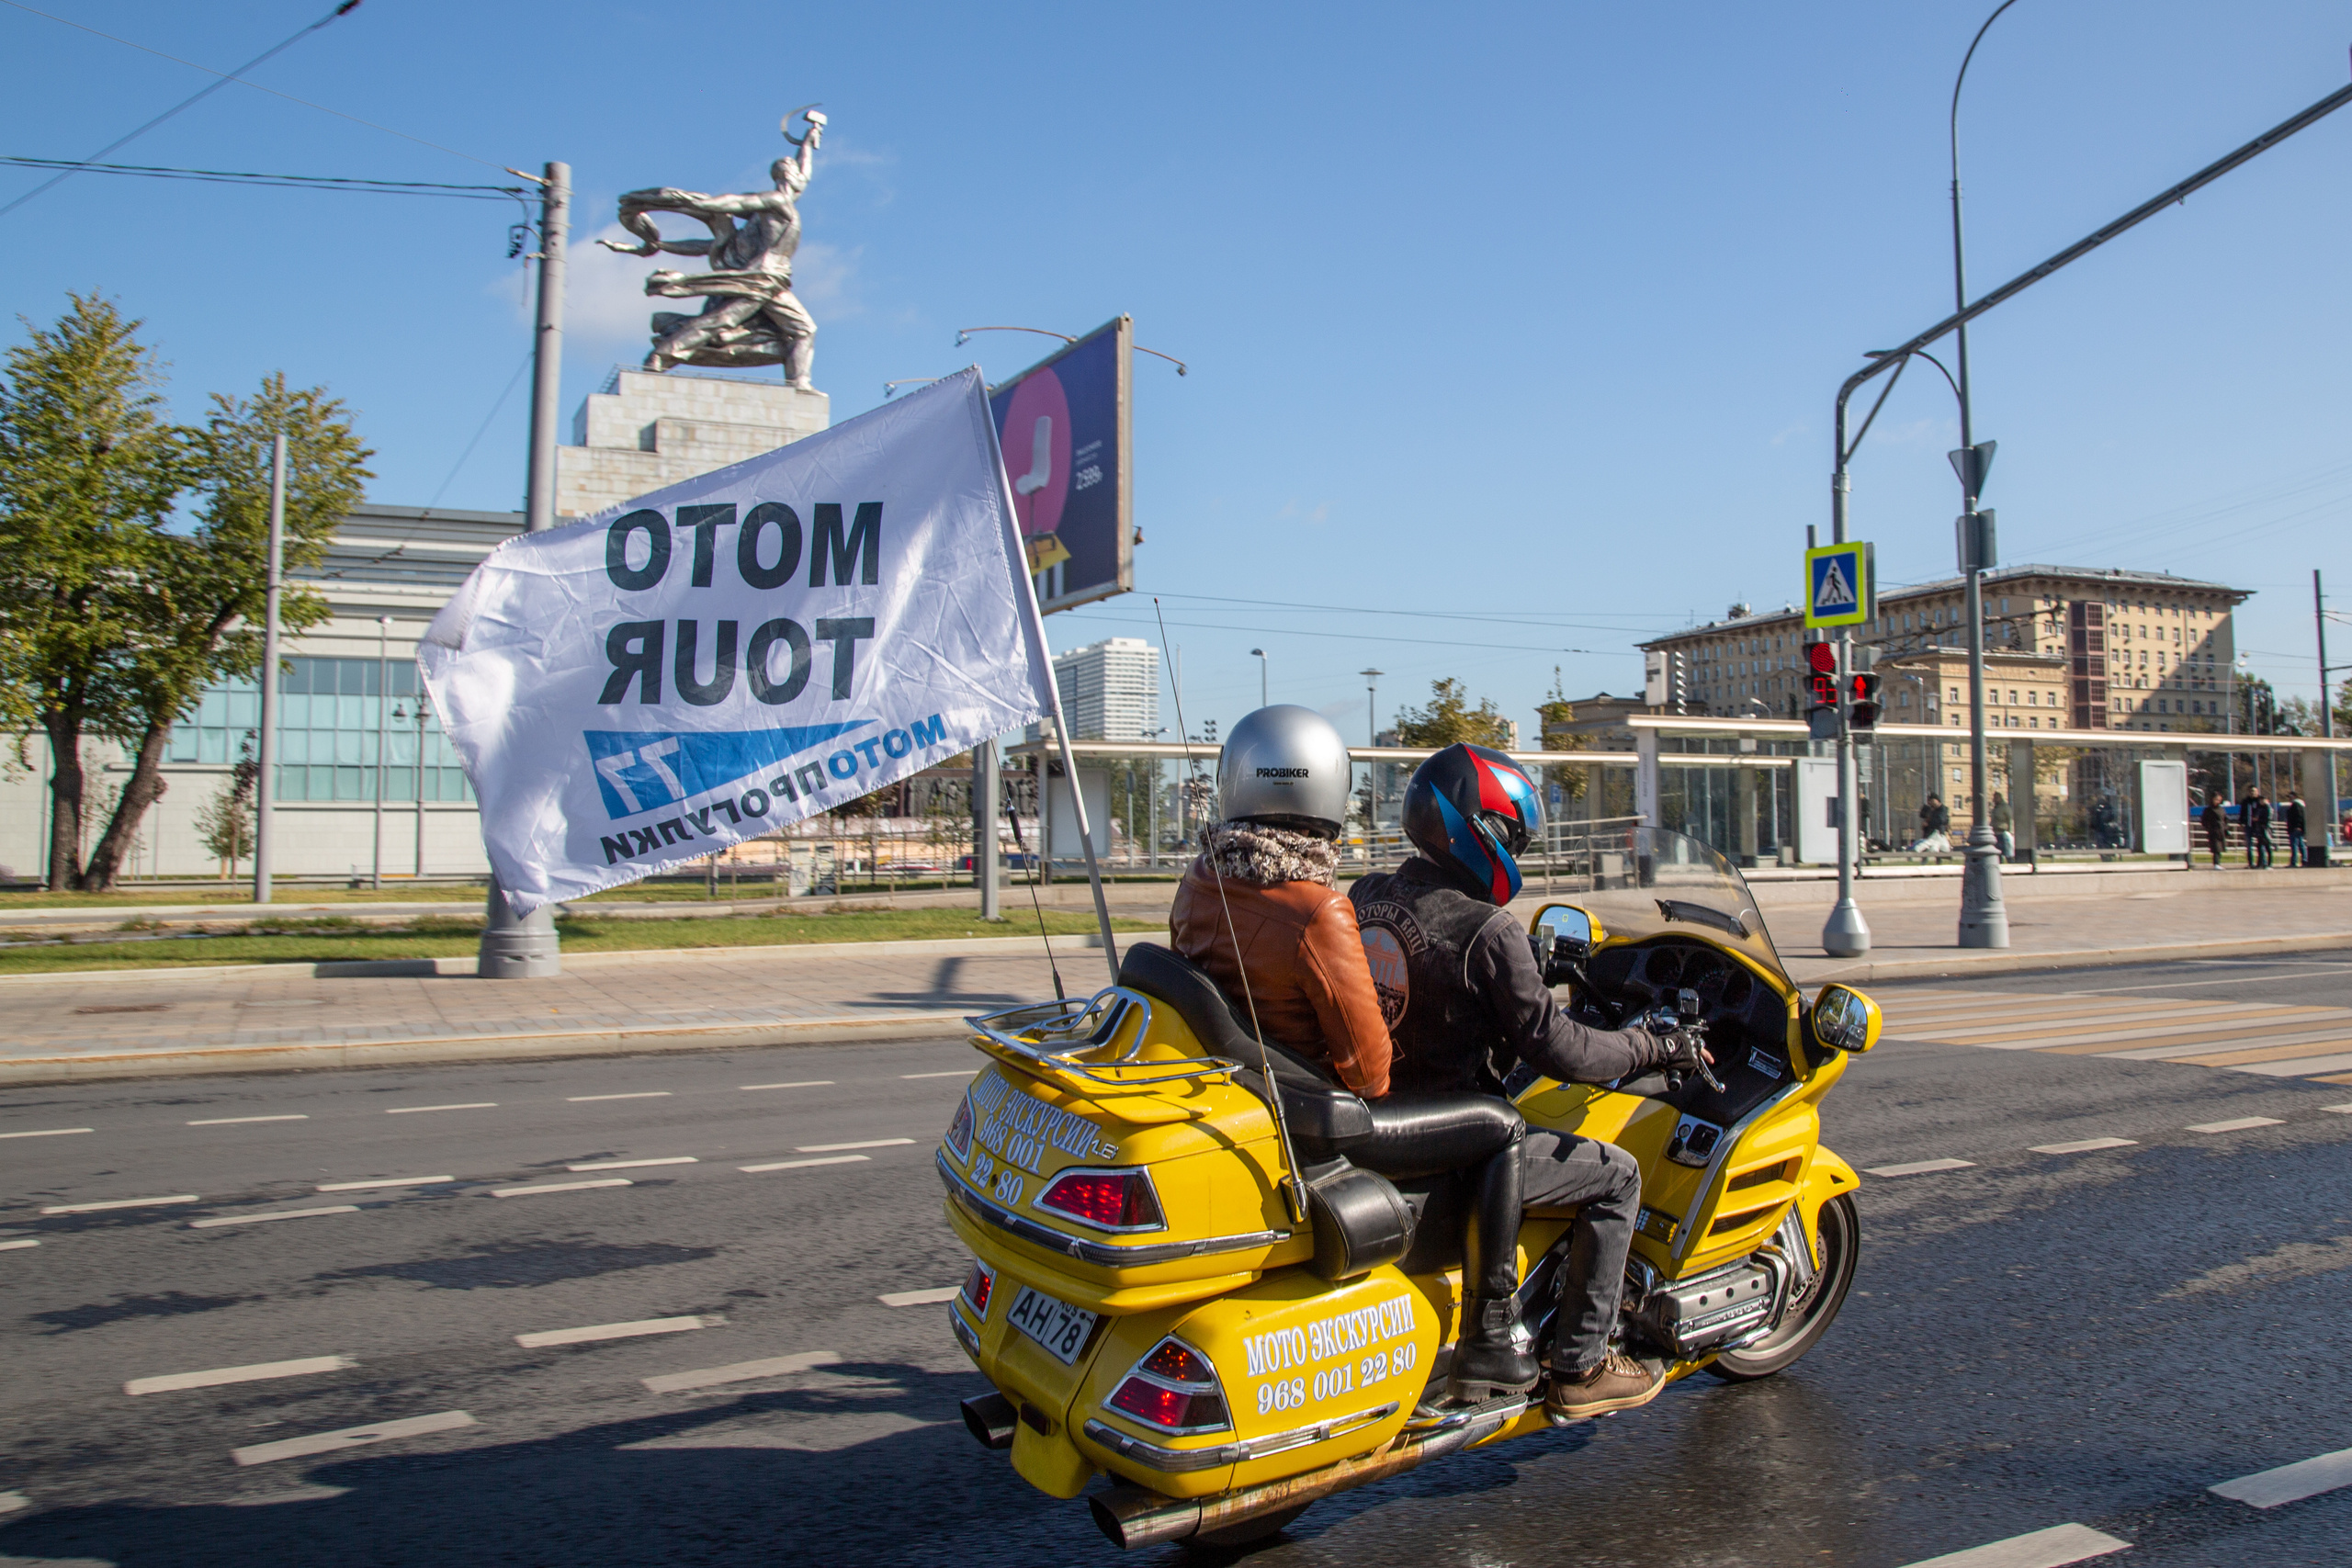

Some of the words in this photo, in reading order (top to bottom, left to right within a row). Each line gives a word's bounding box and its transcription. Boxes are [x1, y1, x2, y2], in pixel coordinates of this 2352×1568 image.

[1256, 767, 1309, 779] PROBIKER
[1357, 903, 1400, 923] ОТОРЫ
[974, 1069, 1010, 1114] МОТО
[999, 1089, 1102, 1159] ЭКСКУРСИИ
[979, 1114, 1008, 1155] 968
[1006, 1133, 1046, 1175] 001
[969, 1152, 994, 1190] 22
[995, 1169, 1023, 1206] 80
[1049, 1313, 1081, 1355] 78
[1243, 1325, 1306, 1377] МОТО
[1308, 1293, 1416, 1361] ЭКСКУРСИИ
[1257, 1377, 1306, 1415] 968
[1313, 1362, 1355, 1402] 001
[1361, 1351, 1387, 1388] 22
[1392, 1341, 1417, 1376] 80
